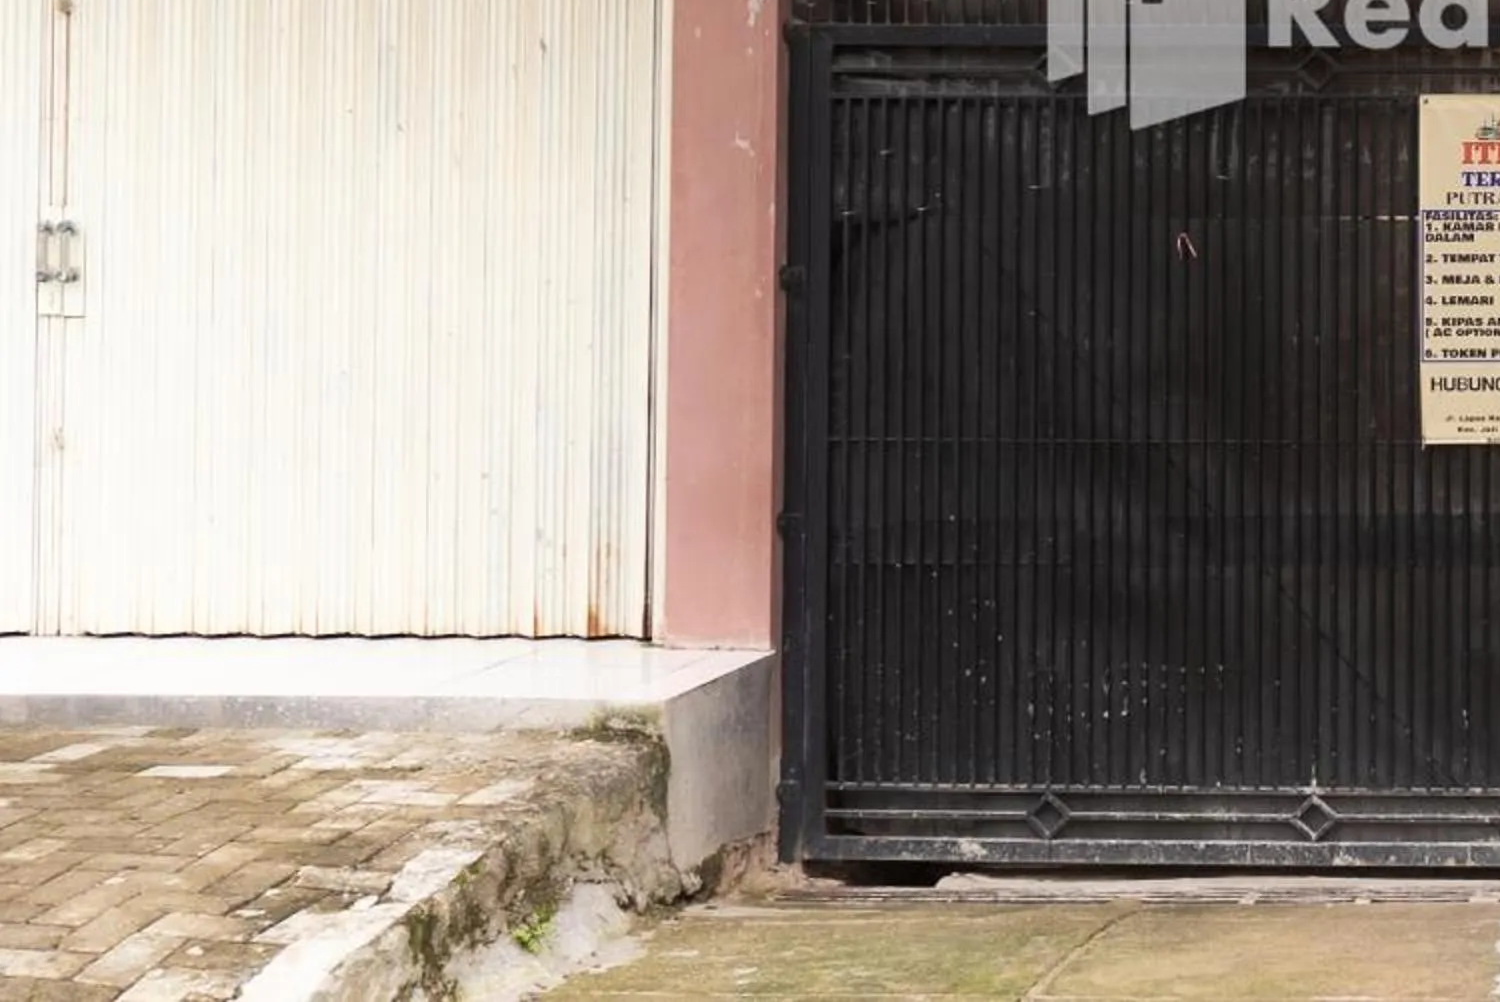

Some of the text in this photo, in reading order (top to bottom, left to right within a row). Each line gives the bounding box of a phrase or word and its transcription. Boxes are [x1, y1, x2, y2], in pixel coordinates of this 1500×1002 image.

[1426, 211, 1498, 220] FASILITAS:
[1426, 223, 1438, 231] 1.
[1443, 222, 1494, 231] KAMAR
[1425, 233, 1475, 242] DALAM
[1426, 255, 1438, 263] 2.
[1442, 254, 1494, 263] TEMPAT
[1426, 276, 1438, 284] 3.
[1442, 275, 1481, 284] MEJA
[1485, 275, 1495, 284] &
[1442, 296, 1494, 305] LEMARI
[1442, 318, 1483, 326] KIPAS
[1442, 349, 1487, 358] TOKEN
